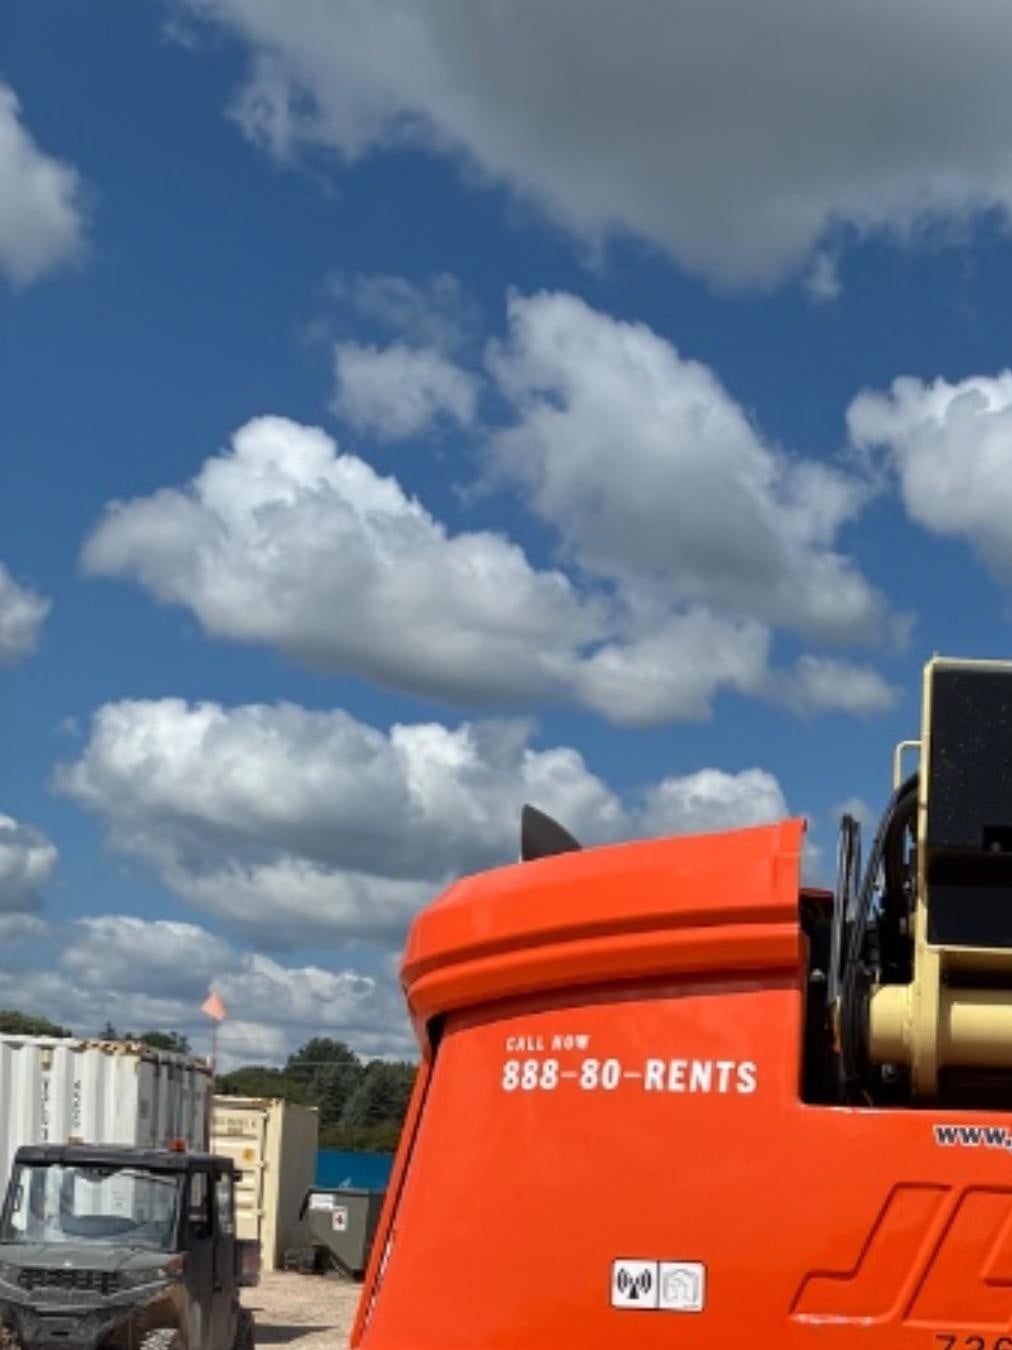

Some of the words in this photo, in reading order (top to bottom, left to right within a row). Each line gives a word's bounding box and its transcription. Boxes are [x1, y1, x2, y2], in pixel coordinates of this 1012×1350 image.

[506, 1037, 545, 1051] CALL
[551, 1034, 590, 1050] NOW
[502, 1058, 757, 1094] 888-80-RENTS
